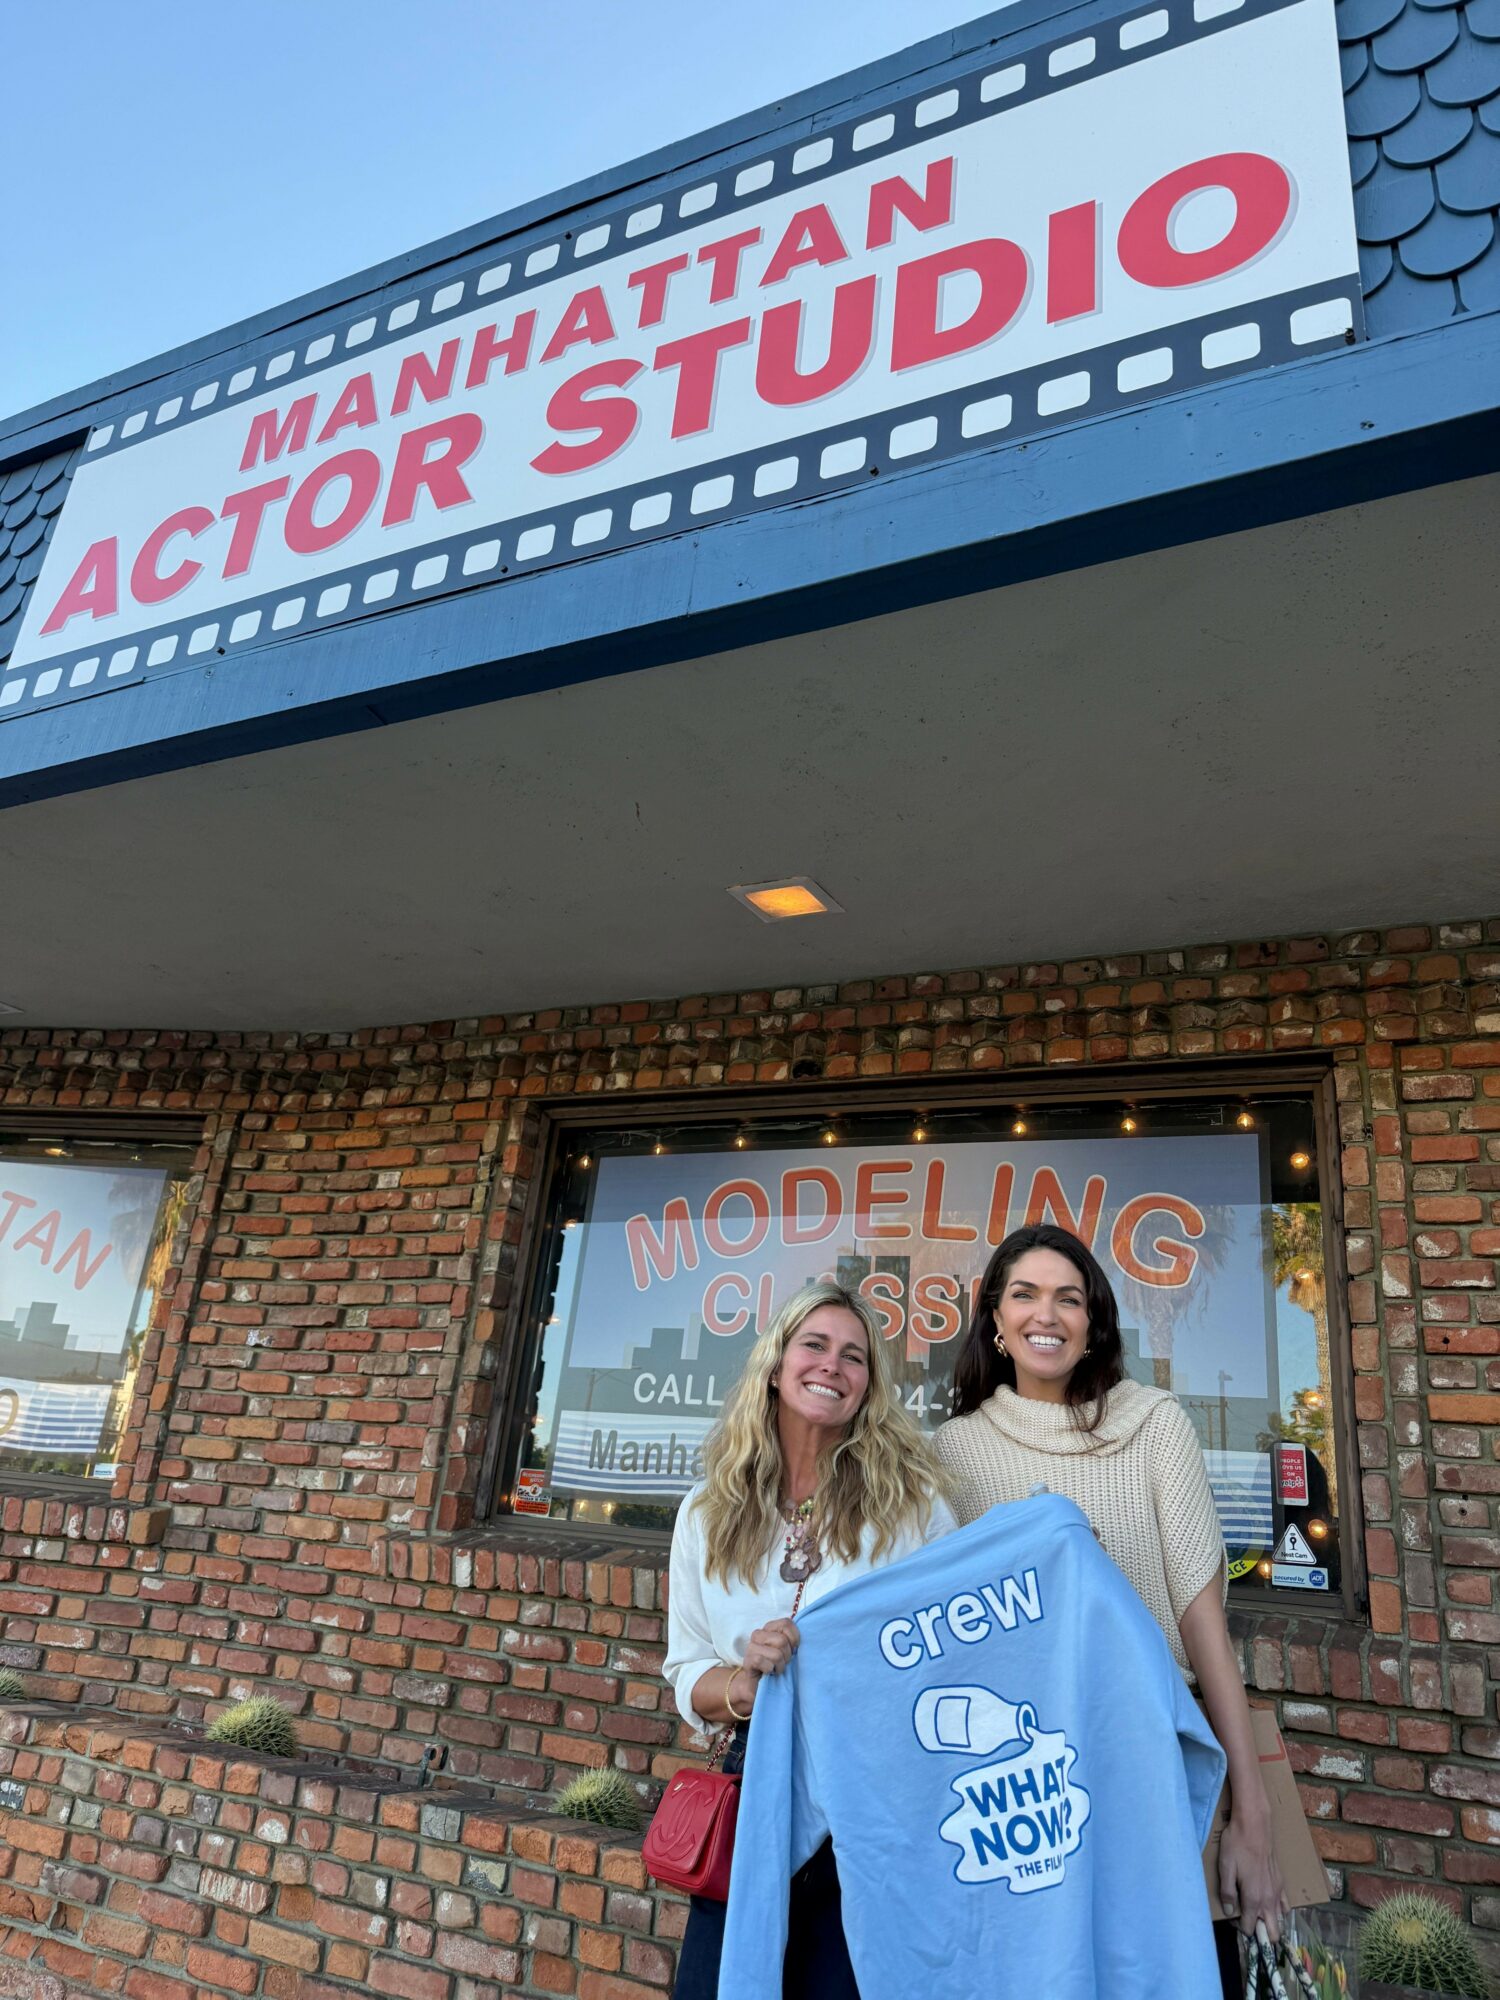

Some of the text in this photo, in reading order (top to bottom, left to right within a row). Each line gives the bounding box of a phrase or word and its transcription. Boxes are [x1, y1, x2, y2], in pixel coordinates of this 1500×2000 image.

[239, 156, 957, 472] MANHATTAN
[38, 152, 1297, 636] ACTOR STUDIO
[625, 1158, 1206, 1291] MODELING
[633, 1372, 725, 1406] CALL
[1281, 1550, 1308, 1559] Nest Cam
[878, 1567, 1044, 1670] crew
[965, 1755, 1066, 1818] WHAT
[970, 1797, 1072, 1866] NOW?
[1014, 1861, 1043, 1878] THE
